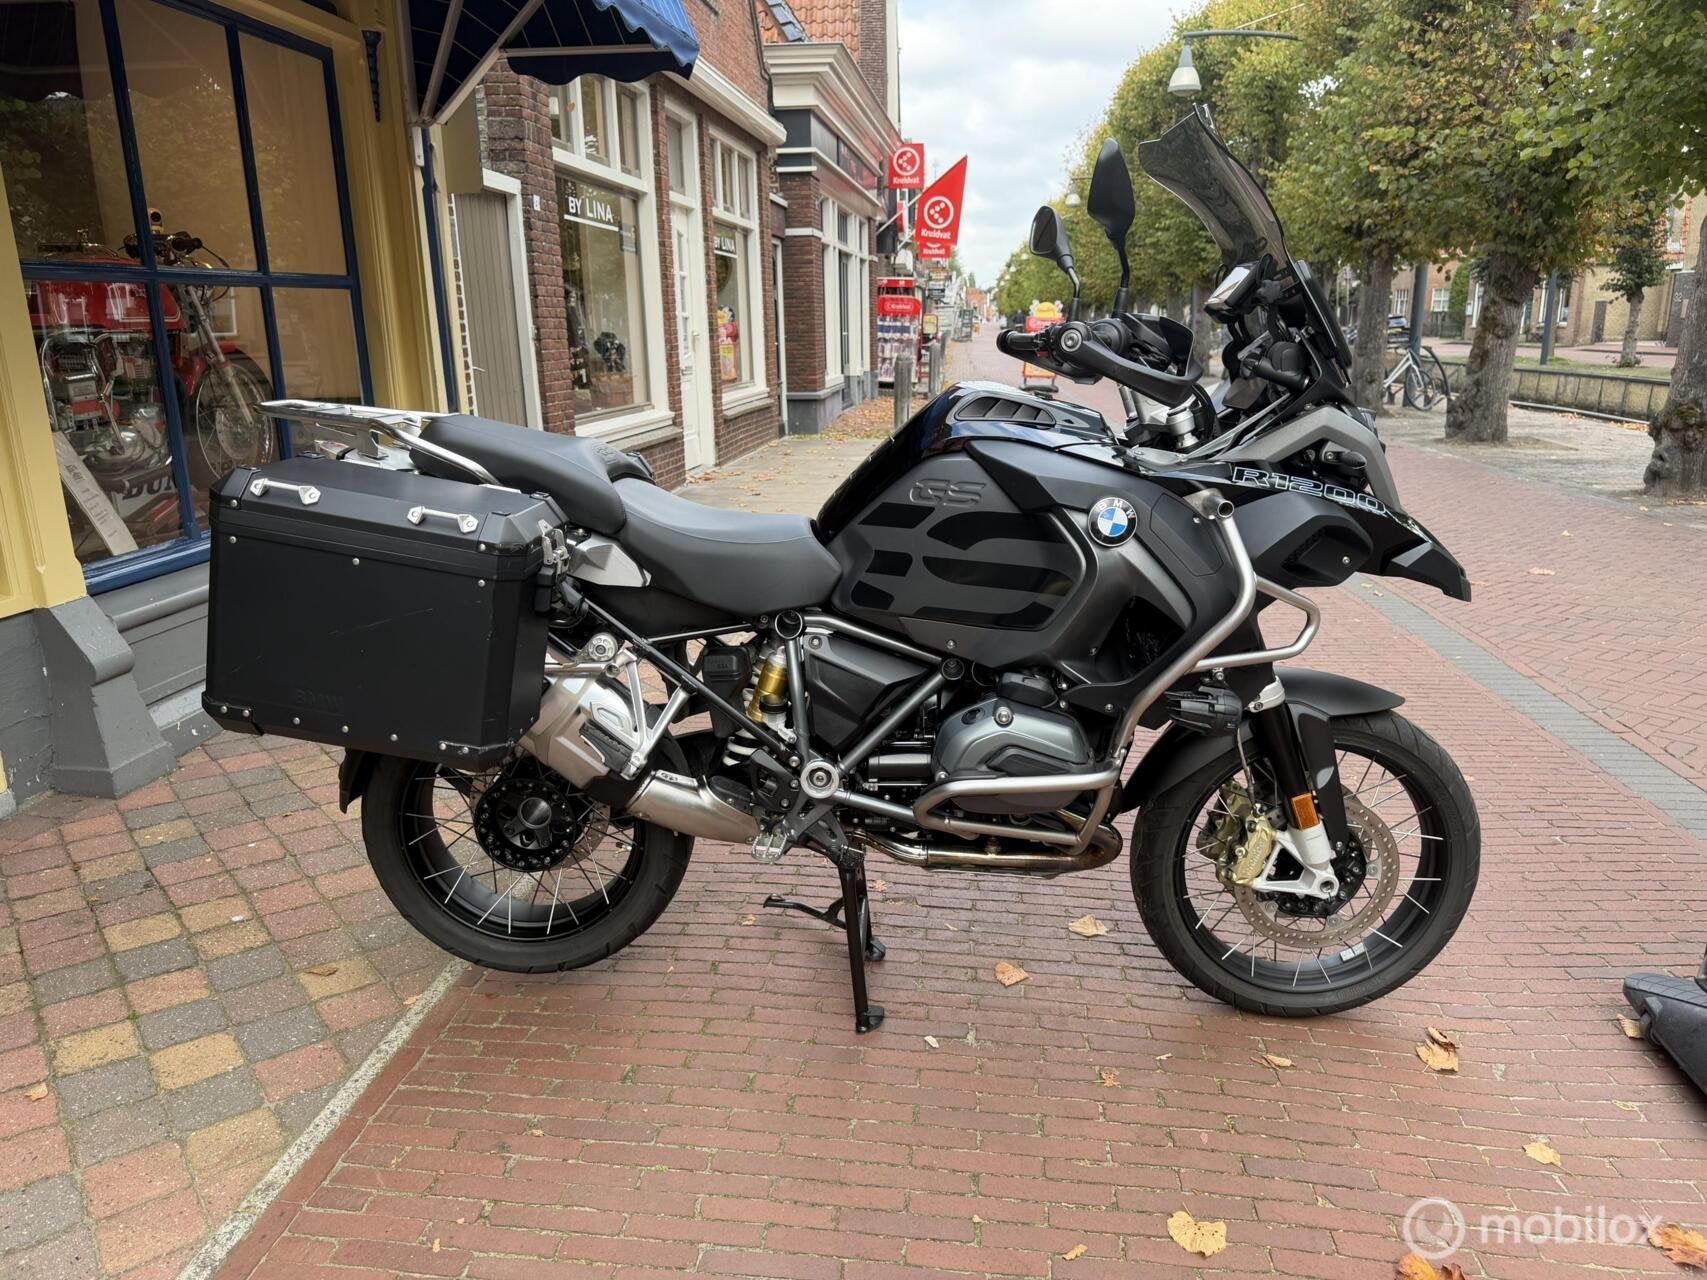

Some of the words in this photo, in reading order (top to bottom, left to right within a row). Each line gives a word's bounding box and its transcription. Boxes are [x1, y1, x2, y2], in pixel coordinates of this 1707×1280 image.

[568, 196, 582, 215] BY
[586, 197, 614, 224] LINA
[721, 236, 736, 254] LINA
[921, 229, 951, 240] Kruidvat
[909, 478, 987, 508] GS
[1232, 466, 1387, 517] R1200
[1099, 499, 1137, 519] BMW
